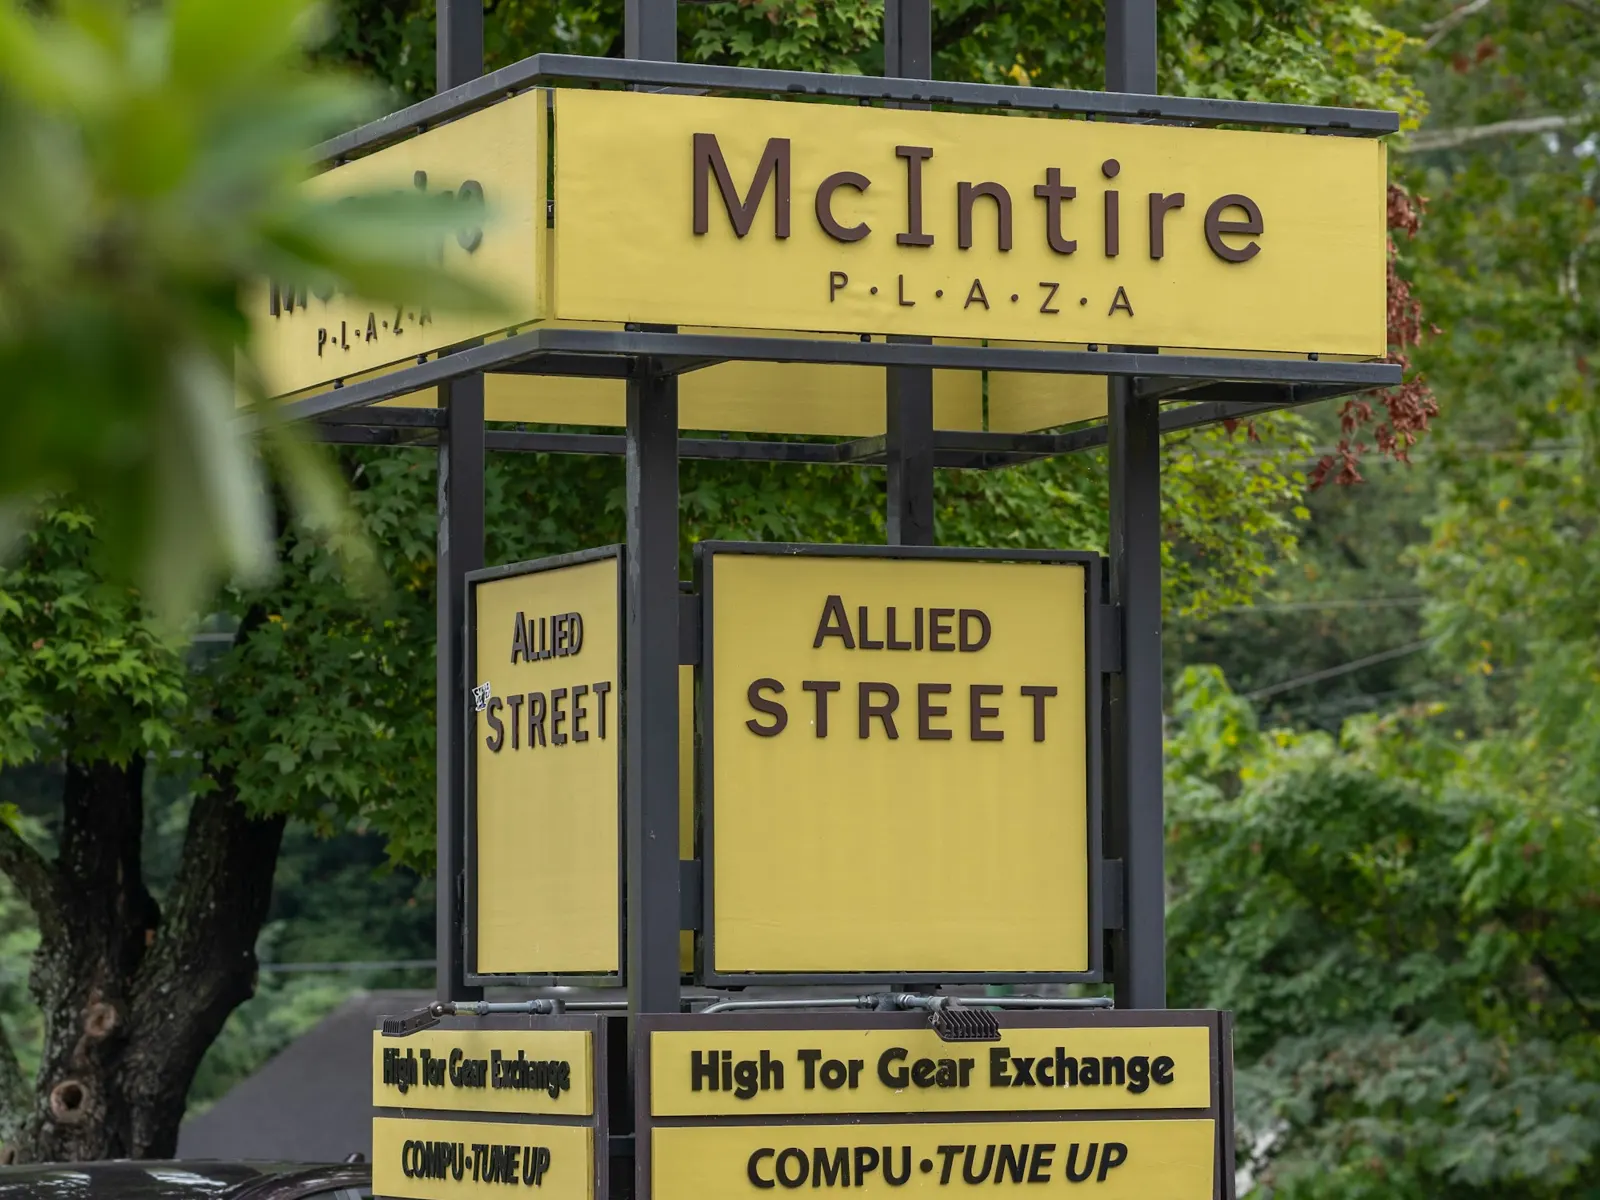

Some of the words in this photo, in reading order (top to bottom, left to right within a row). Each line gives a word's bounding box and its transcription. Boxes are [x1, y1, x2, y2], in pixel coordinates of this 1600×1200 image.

[692, 132, 1264, 265] McIntire
[485, 680, 613, 754] STREET
[745, 677, 1058, 743] STREET
[383, 1047, 418, 1095] High
[420, 1048, 447, 1087] Tor
[448, 1047, 489, 1089] Gear
[490, 1049, 571, 1100] Exchange
[691, 1049, 784, 1100] High
[797, 1049, 864, 1090] Tor
[877, 1047, 975, 1089] Gear
[989, 1046, 1175, 1094] Exchange
[522, 1146, 551, 1187] UP
[1065, 1142, 1128, 1183] UP
